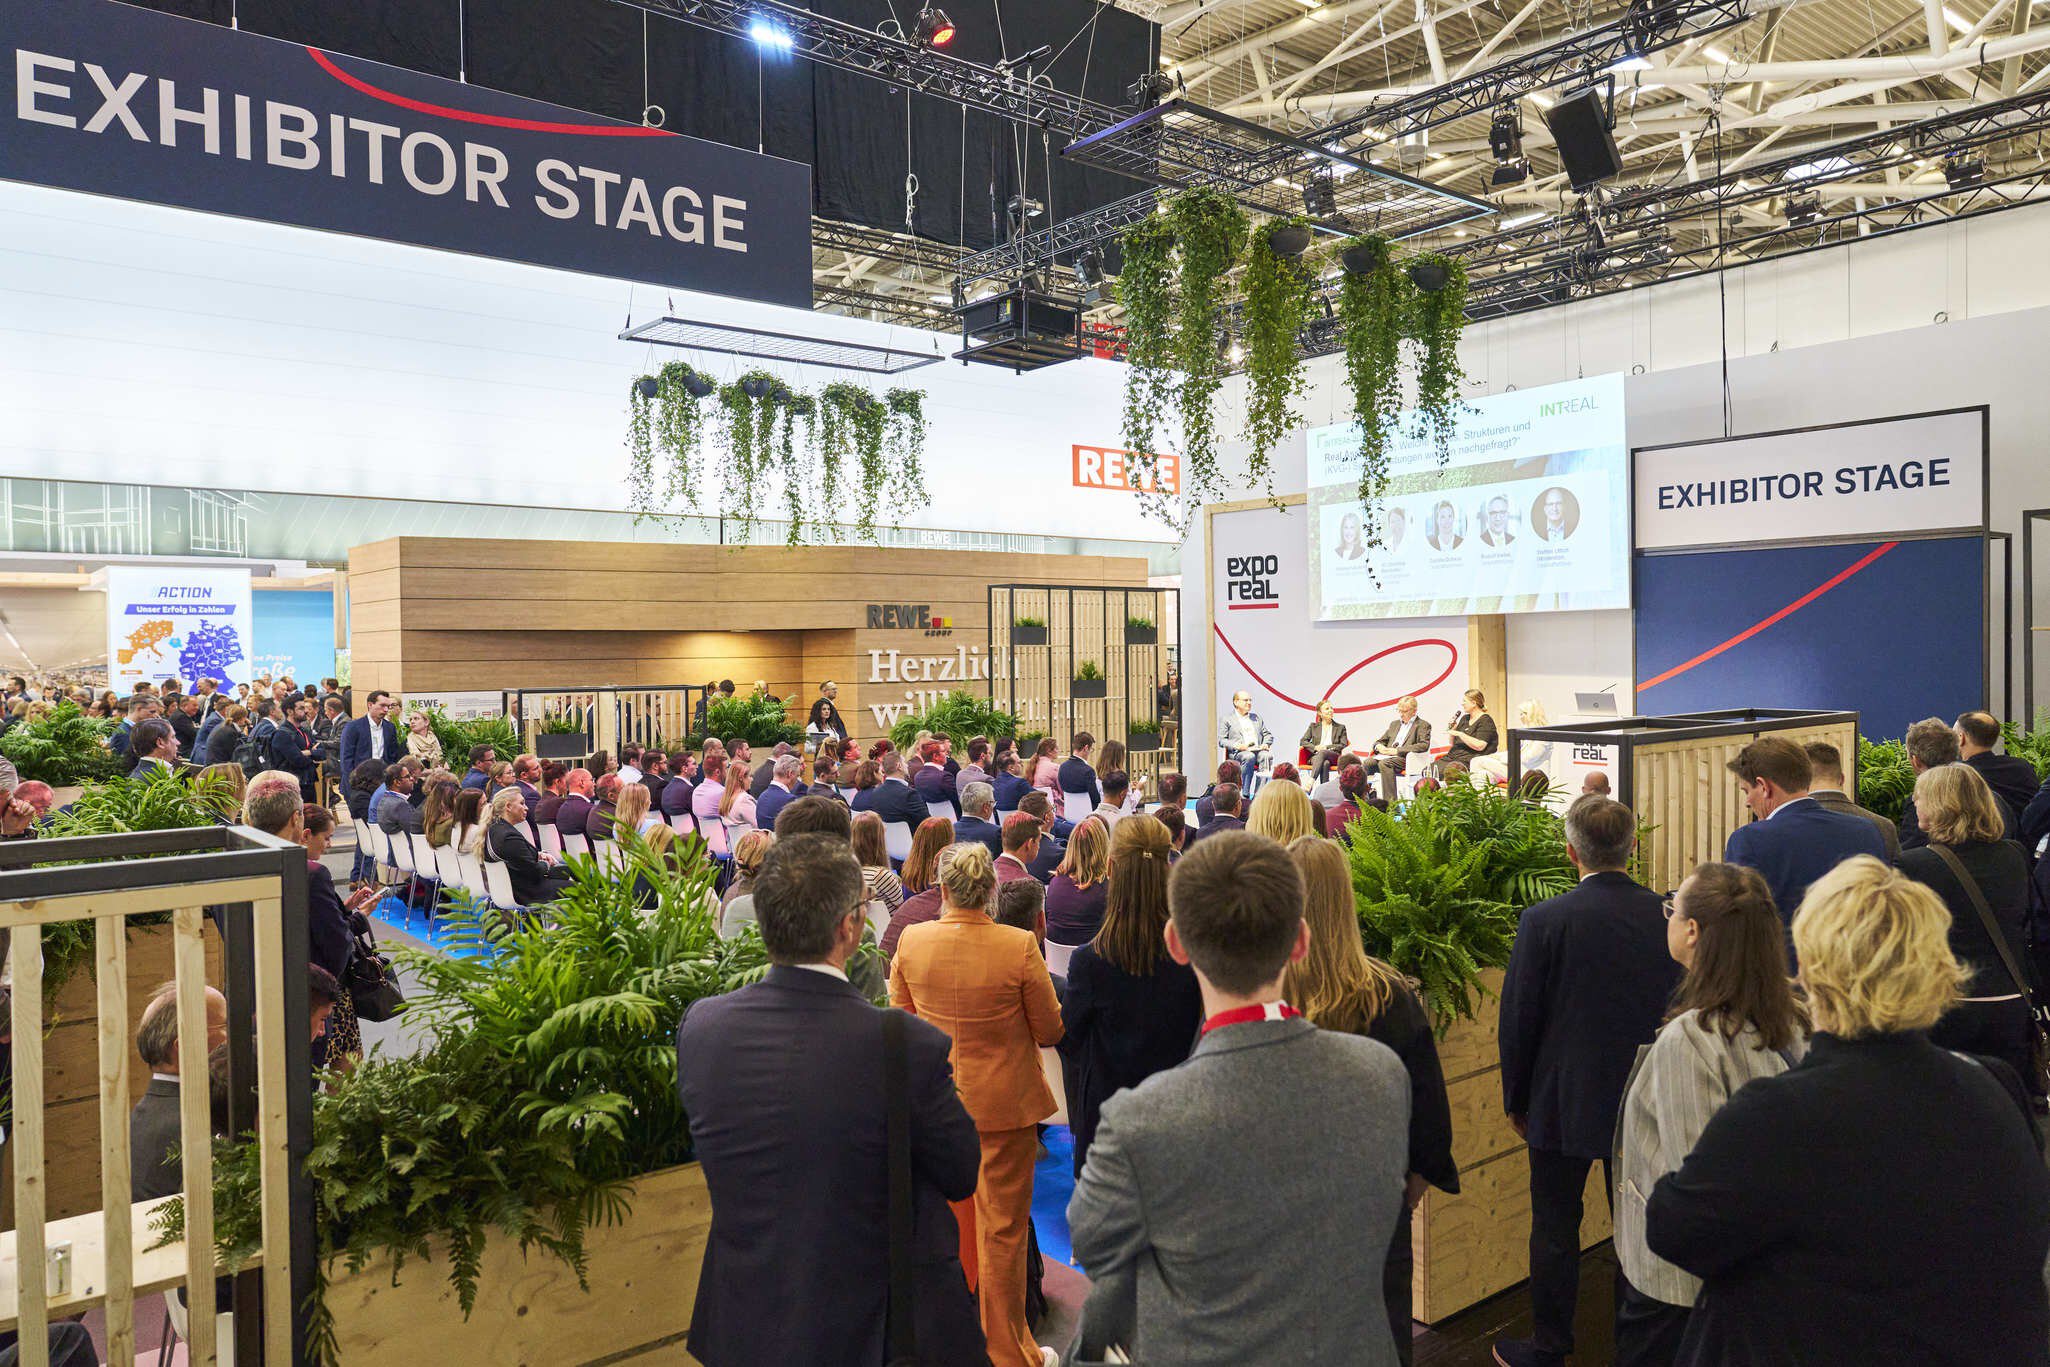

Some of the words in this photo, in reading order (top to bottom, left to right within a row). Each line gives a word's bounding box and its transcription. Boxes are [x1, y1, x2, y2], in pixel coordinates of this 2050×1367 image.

[15, 48, 511, 210] EXHIBITOR
[534, 158, 749, 253] STAGE
[1539, 394, 1599, 417] INTREAL
[1463, 423, 1511, 441] Strukturen
[1512, 416, 1531, 433] und
[1078, 448, 1176, 491] REWE
[1658, 470, 1824, 510] EXHIBITOR
[1834, 457, 1950, 495] STAGE
[1227, 554, 1279, 583] expo
[157, 586, 212, 598] ACTION
[136, 605, 161, 614] Unser
[162, 605, 188, 615] Erfolg
[189, 605, 197, 613] in
[198, 605, 226, 614] Zahlen
[866, 604, 931, 629] REWE
